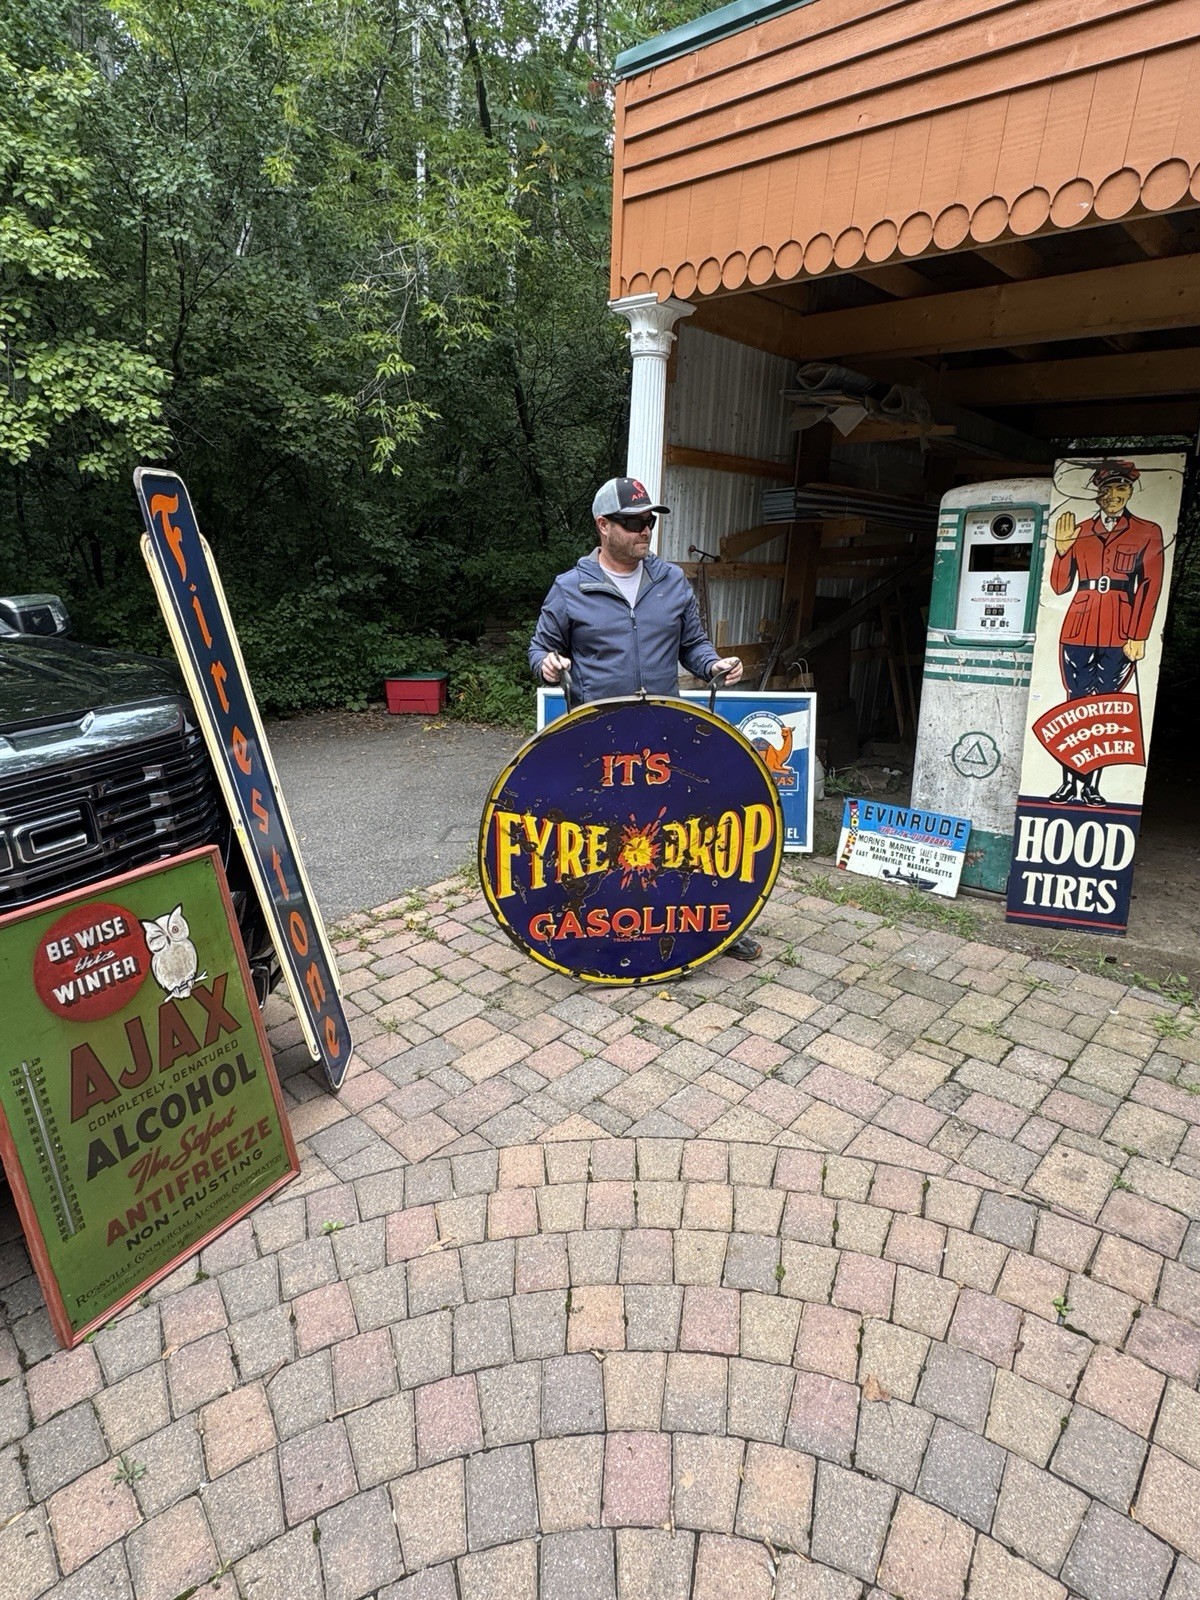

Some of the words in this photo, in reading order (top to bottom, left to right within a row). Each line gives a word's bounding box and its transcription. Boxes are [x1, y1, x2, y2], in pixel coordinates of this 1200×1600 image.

[1041, 701, 1133, 743] AUTHORIZED
[1064, 722, 1119, 748] HOOD
[151, 493, 341, 1058] Firestone
[602, 747, 671, 787] IT'S
[1071, 741, 1135, 767] DEALER
[784, 827, 800, 839] EL
[864, 806, 966, 839] EVINRUDE
[1015, 816, 1136, 872] HOOD
[493, 811, 610, 899] FYRE
[662, 804, 774, 883] DROP
[870, 846, 886, 854] MAIN
[890, 851, 916, 861] STREET
[889, 841, 916, 854] MARINE
[939, 853, 957, 864] SERVICE
[907, 862, 952, 878] MASSACHUSETTS
[1022, 871, 1118, 915] TIRES
[46, 937, 75, 963] BE
[74, 916, 127, 949] WISE
[529, 904, 732, 941] GASOLINE
[52, 956, 137, 1005] WINTER
[74, 950, 116, 973] this
[70, 972, 242, 1124] AJAX
[173, 1039, 239, 1084] DENATURED
[87, 1052, 257, 1182] ALCOHOL
[127, 1145, 171, 1196] The
[169, 1105, 237, 1171] Safest
[107, 1116, 272, 1247] ANTIFREEZE
